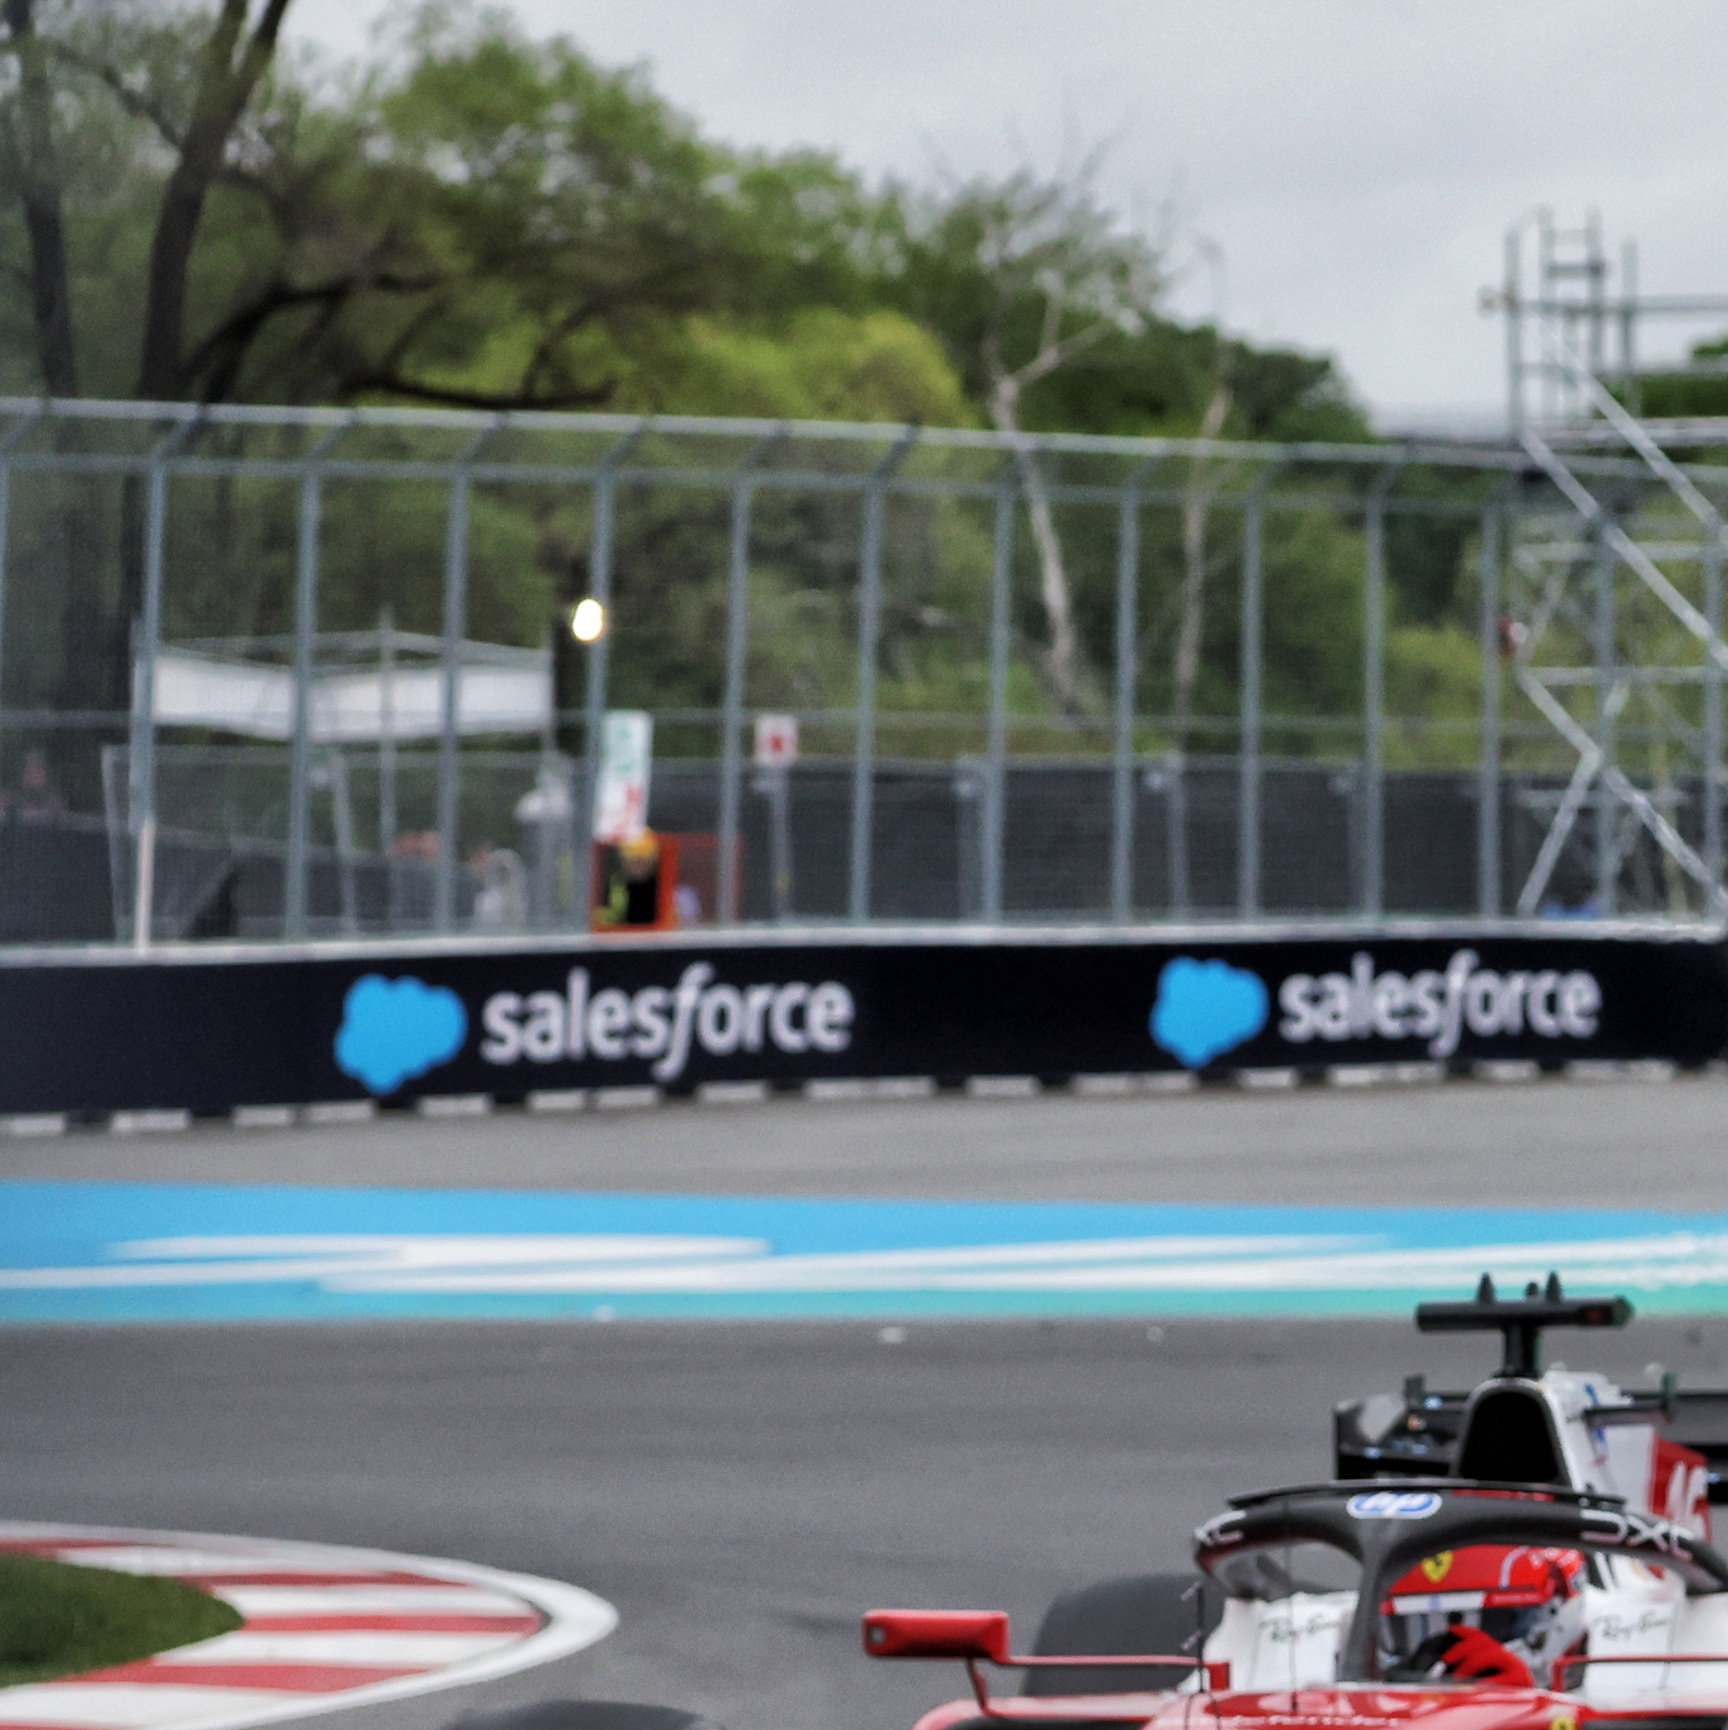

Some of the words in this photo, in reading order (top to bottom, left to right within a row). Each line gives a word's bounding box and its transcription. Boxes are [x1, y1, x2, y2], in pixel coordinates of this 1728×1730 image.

[482, 967, 854, 1079] salesforce
[1280, 953, 1600, 1057] salesforce
[1580, 1510, 1694, 1561] DXC
